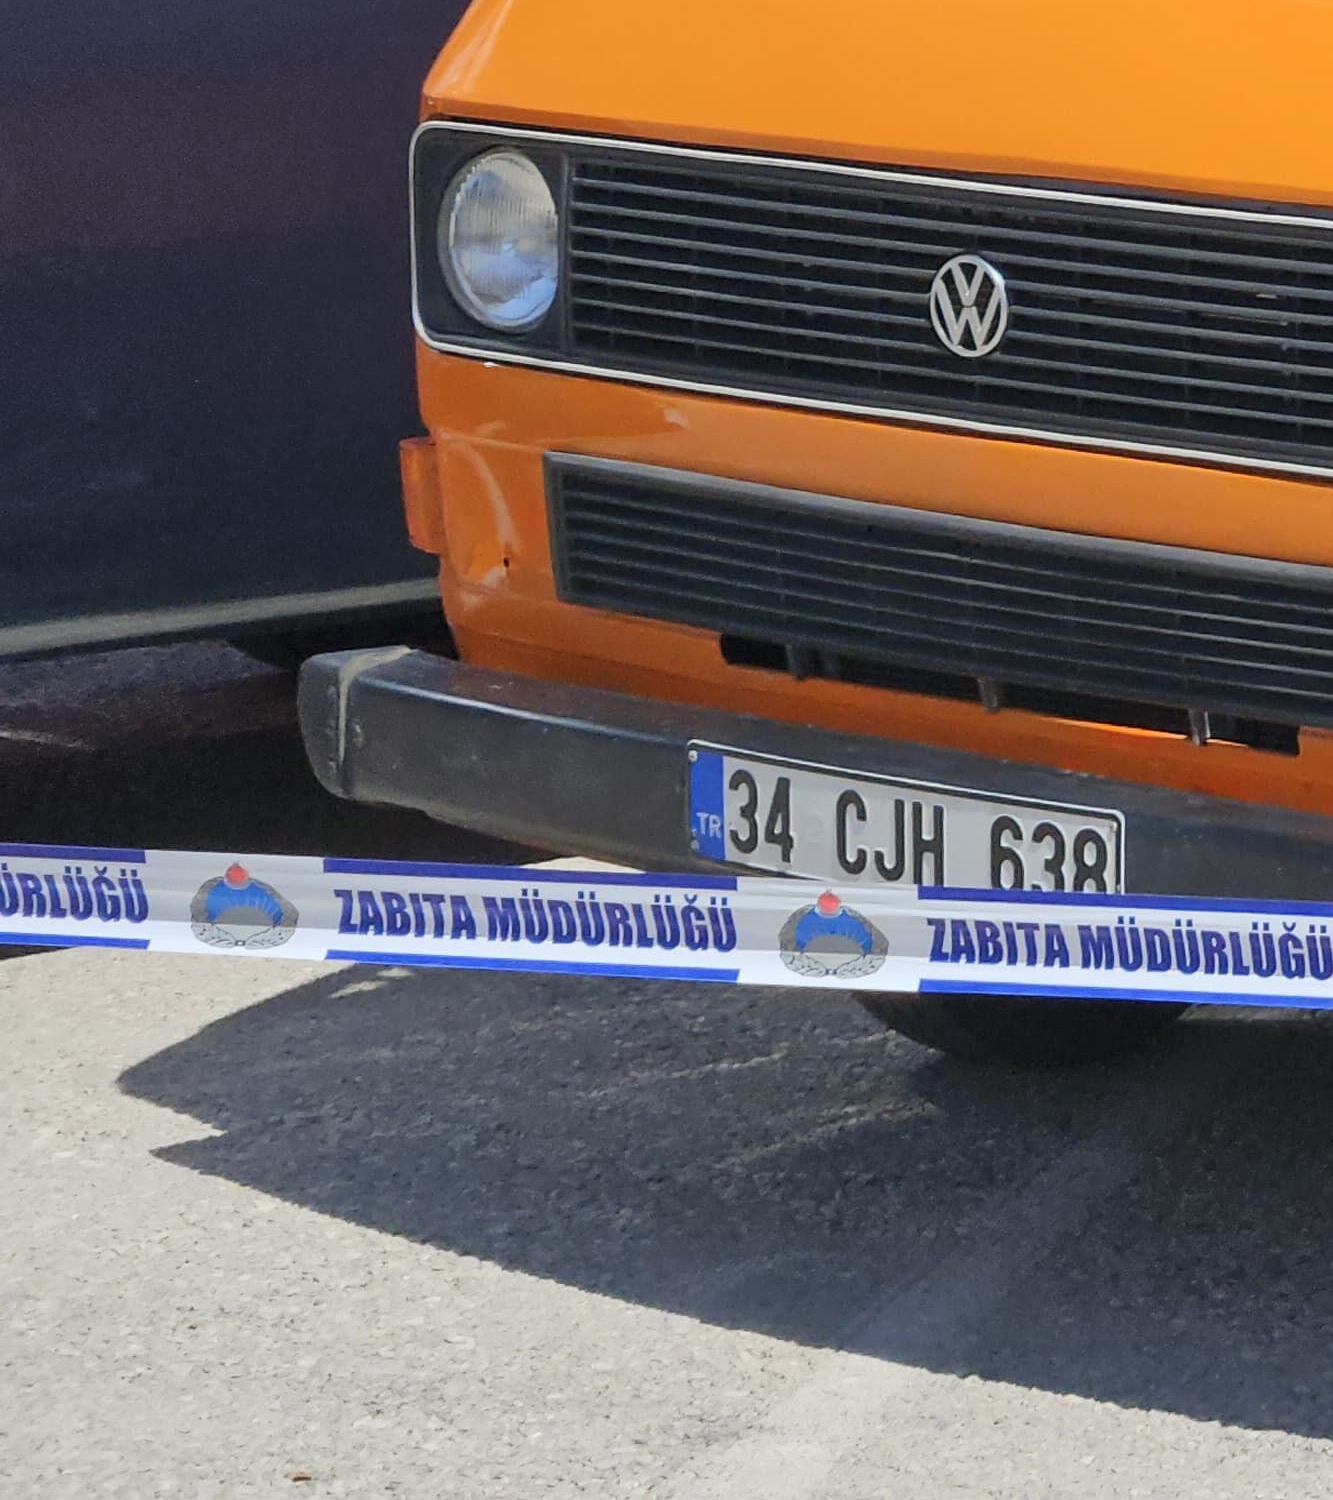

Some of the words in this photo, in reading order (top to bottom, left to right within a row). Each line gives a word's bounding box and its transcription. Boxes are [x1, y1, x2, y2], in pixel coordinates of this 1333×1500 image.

[930, 254, 1009, 358] VW
[696, 811, 721, 839] TR
[728, 768, 795, 863] 34
[836, 789, 945, 887] CJH
[990, 816, 1108, 894] 638
[334, 888, 477, 942] ZABITA
[487, 886, 737, 953] MÜDÜRLÜĞÜ
[926, 917, 1070, 970] ZABITA
